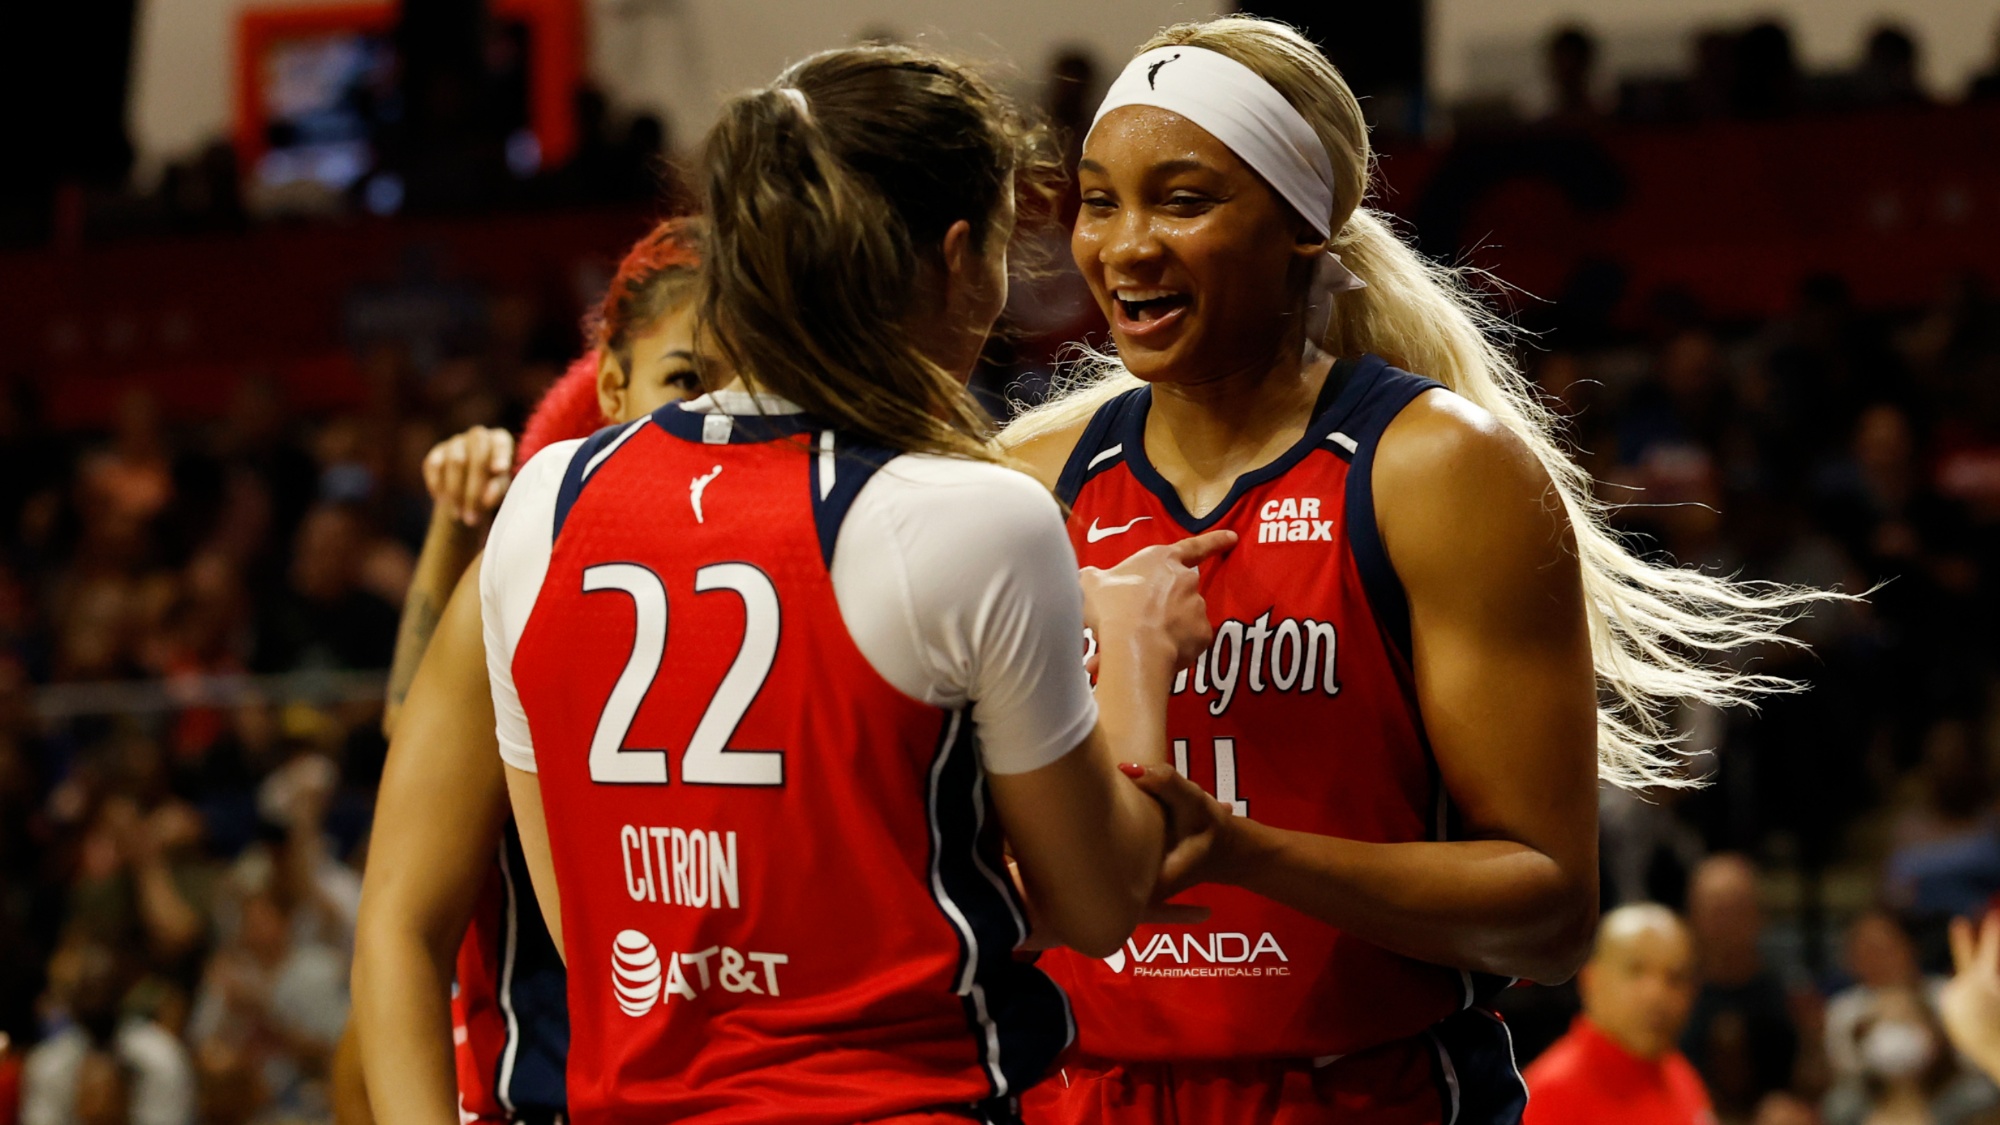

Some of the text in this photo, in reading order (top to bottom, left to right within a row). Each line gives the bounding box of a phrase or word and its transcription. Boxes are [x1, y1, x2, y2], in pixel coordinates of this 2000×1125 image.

[1260, 497, 1321, 521] CAR
[1258, 519, 1334, 544] max
[582, 561, 785, 787] 22
[620, 824, 740, 909] CITRON
[1126, 931, 1289, 963] VANDA
[664, 945, 789, 1005] AT&T
[1133, 967, 1262, 977] PHARMACEUTICALS
